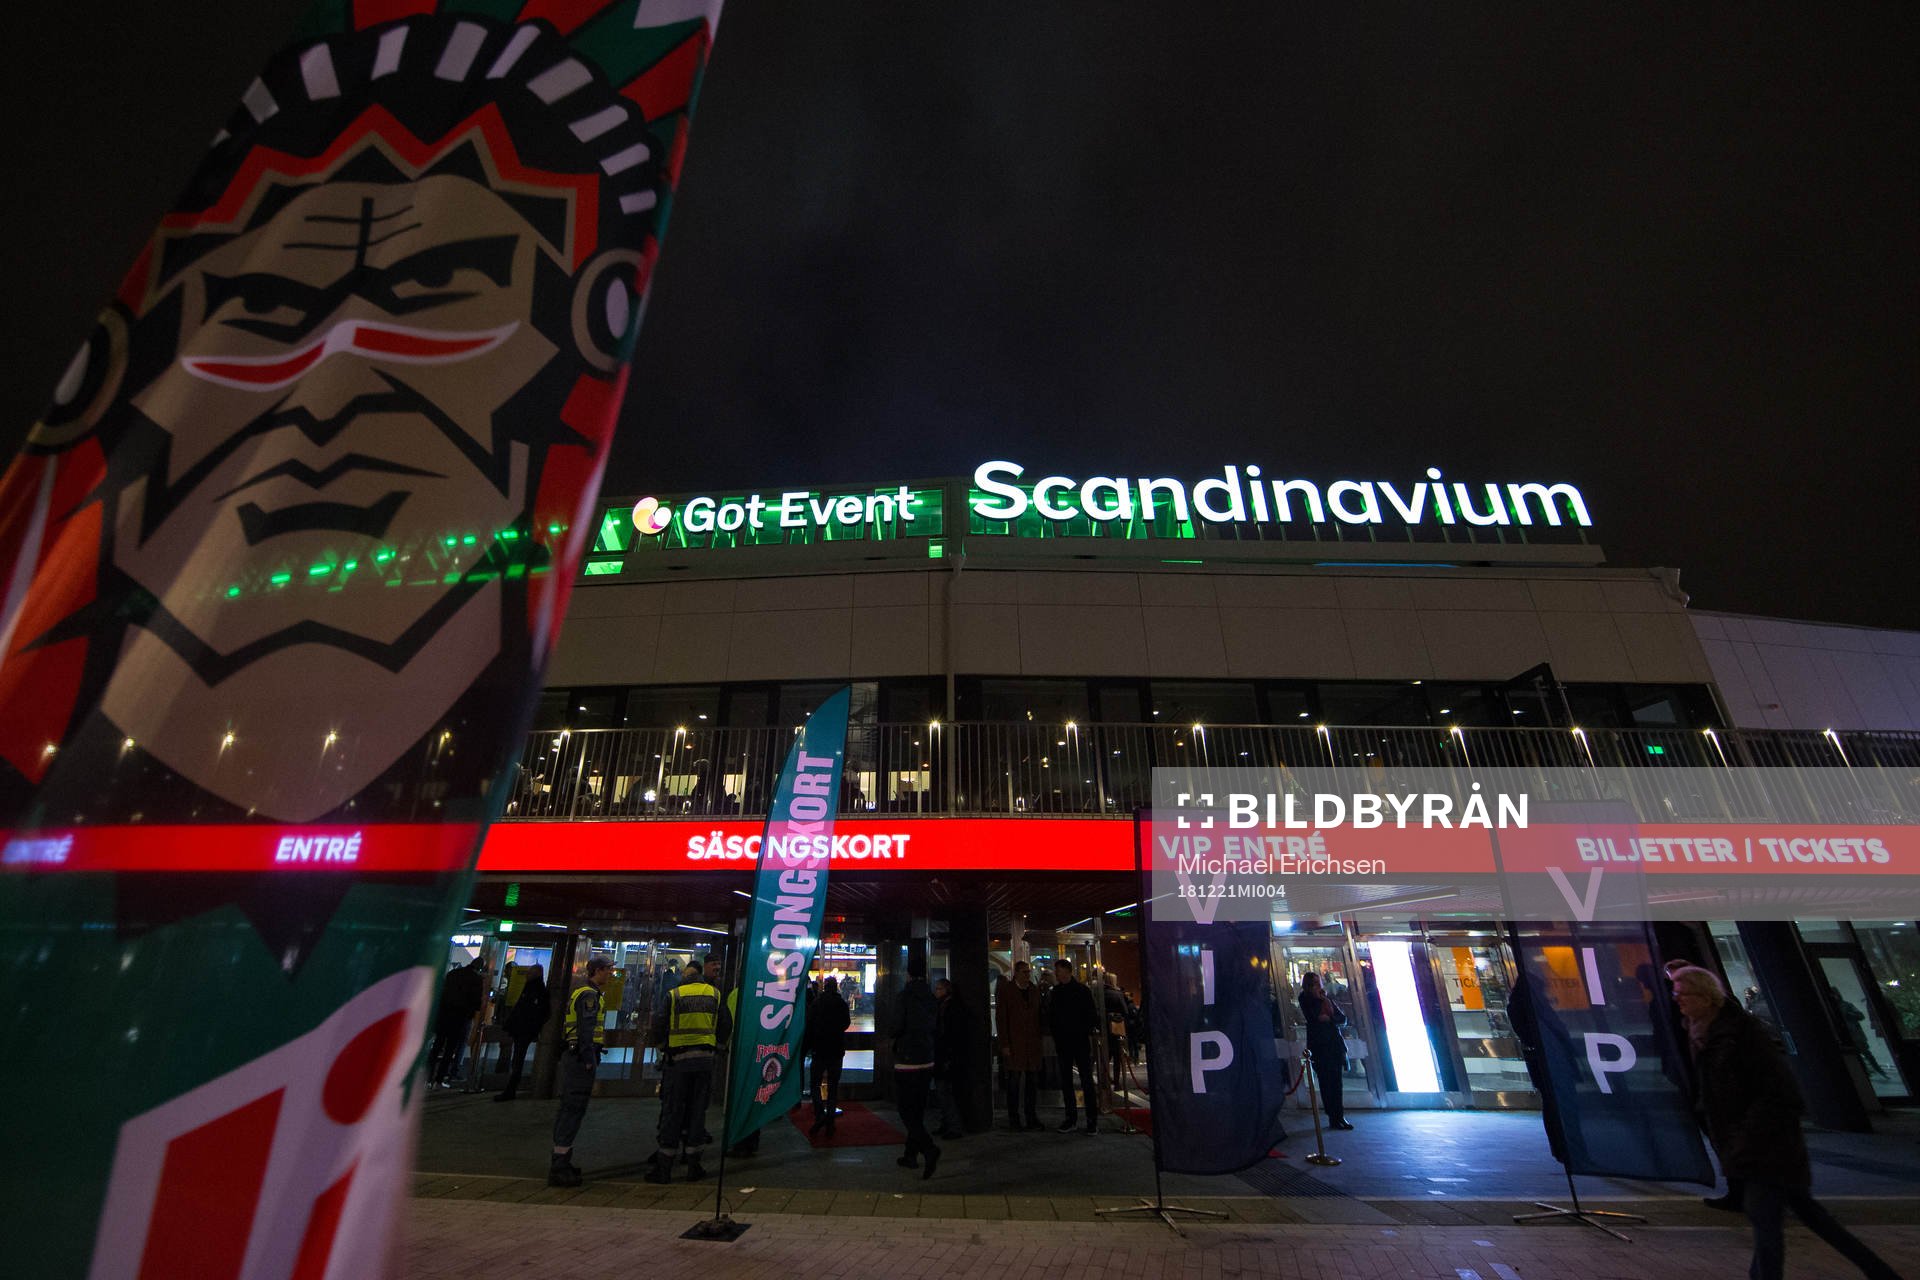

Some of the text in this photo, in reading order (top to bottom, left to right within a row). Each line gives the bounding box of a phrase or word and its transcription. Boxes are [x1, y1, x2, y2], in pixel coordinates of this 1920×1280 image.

[682, 485, 915, 533] Got Event
[971, 460, 1594, 528] Scandinavium
[275, 831, 362, 862] ENTRÉ
[686, 830, 911, 861] SÄSONGSKORT
[1158, 830, 1329, 862] VIP ENTRÉ
[1576, 836, 1738, 863] BILJETTER
[1758, 837, 1891, 864] TICKETS
[755, 750, 836, 1031] SÄSONGSKORT
